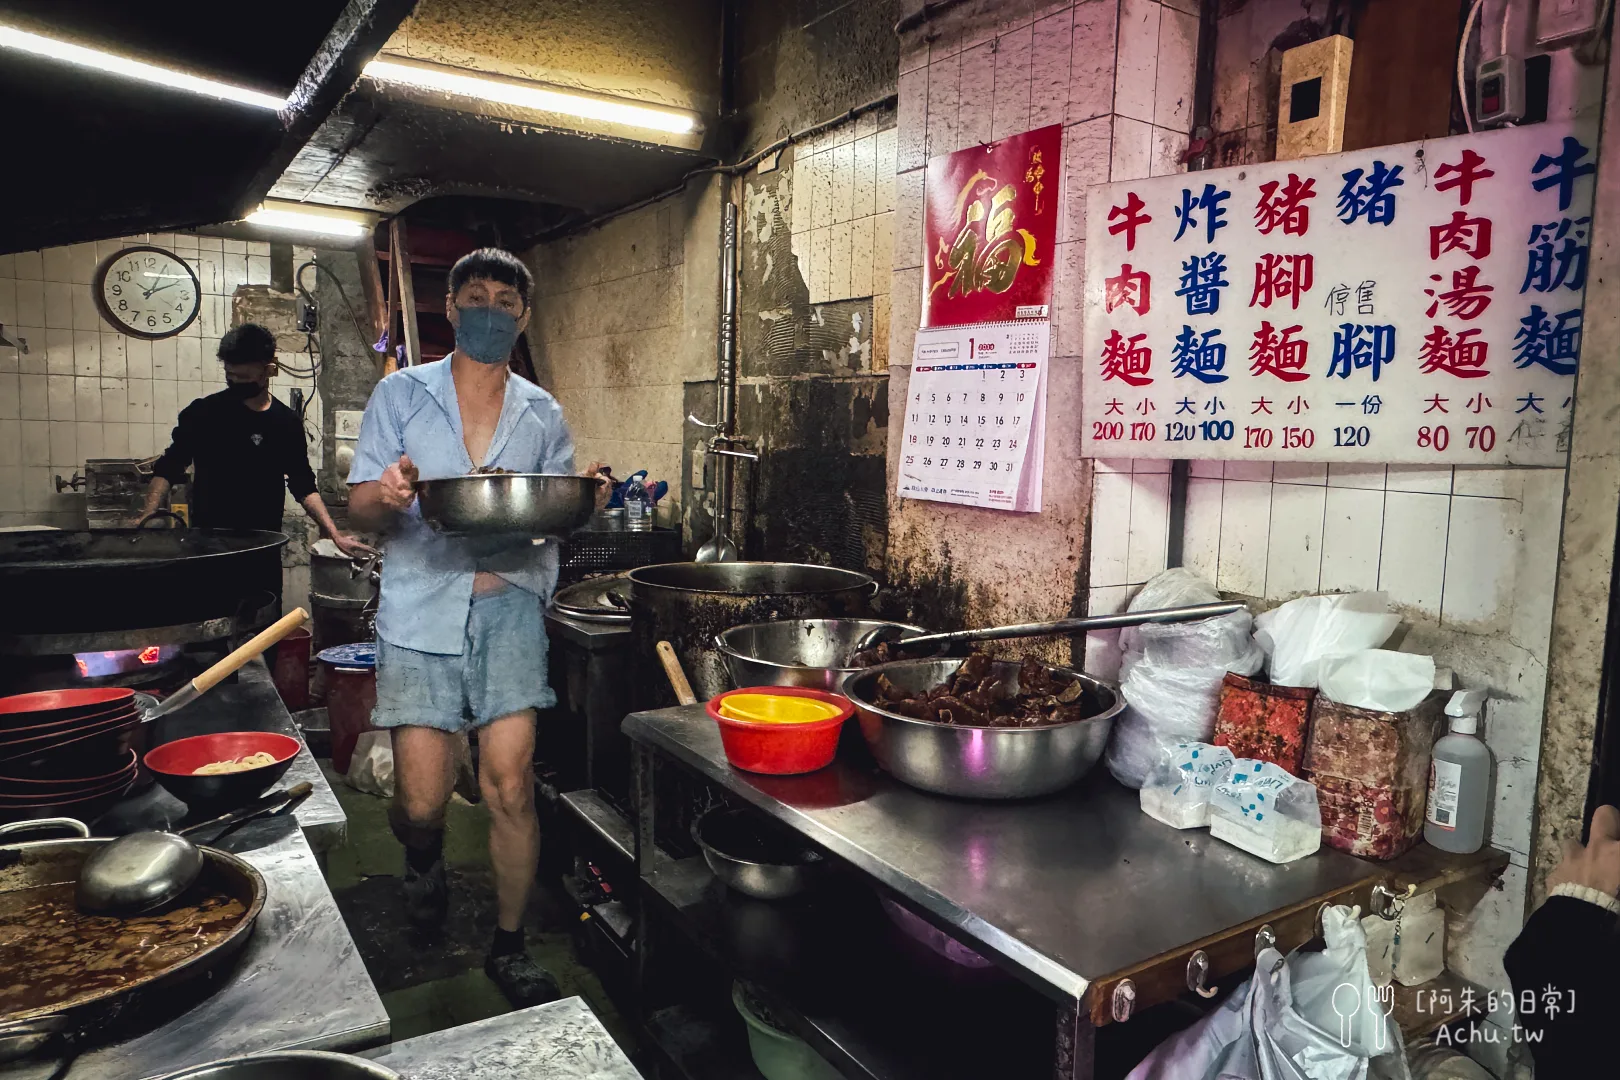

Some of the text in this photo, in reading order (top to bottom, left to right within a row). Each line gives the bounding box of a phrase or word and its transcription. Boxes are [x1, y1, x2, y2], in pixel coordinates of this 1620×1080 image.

[144, 257, 156, 269] 12
[1418, 149, 1495, 379] 牛肉湯麵
[1512, 136, 1596, 375] 牛筋麵
[128, 261, 140, 271] 11
[117, 271, 131, 282] 10
[1171, 184, 1232, 384] 炸醬麵
[1248, 173, 1317, 382] 豬腳麵
[112, 284, 122, 296] 9
[1100, 192, 1154, 386] 牛肉麵
[1324, 280, 1377, 316] 停售
[118, 300, 128, 311] 8
[175, 303, 183, 313] 4
[131, 311, 140, 321] 7
[147, 316, 156, 327] 6
[162, 313, 171, 323] 5
[982, 370, 1024, 379] 1 2 3
[915, 393, 1024, 402] 4 5 6 7 8 9 10
[1105, 397, 1156, 416] 大 小
[1175, 396, 1225, 415] 大 小
[1251, 395, 1310, 415] 大 小
[1335, 394, 1382, 414] 一份
[1423, 392, 1492, 414] 大 小
[1515, 392, 1544, 414] 大
[912, 414, 1020, 425] 11 12 13 14 15 16 17
[1092, 421, 1156, 441] 200 170
[1164, 420, 1235, 442] 120 100
[1243, 425, 1315, 449] 170 150
[1333, 426, 1370, 447] 120
[1417, 425, 1449, 451] 80
[1465, 425, 1496, 452] 70
[910, 434, 1017, 448] 18 19 20 21 22 23 24
[906, 456, 1013, 472] 25 26 27 28 29 30 31
